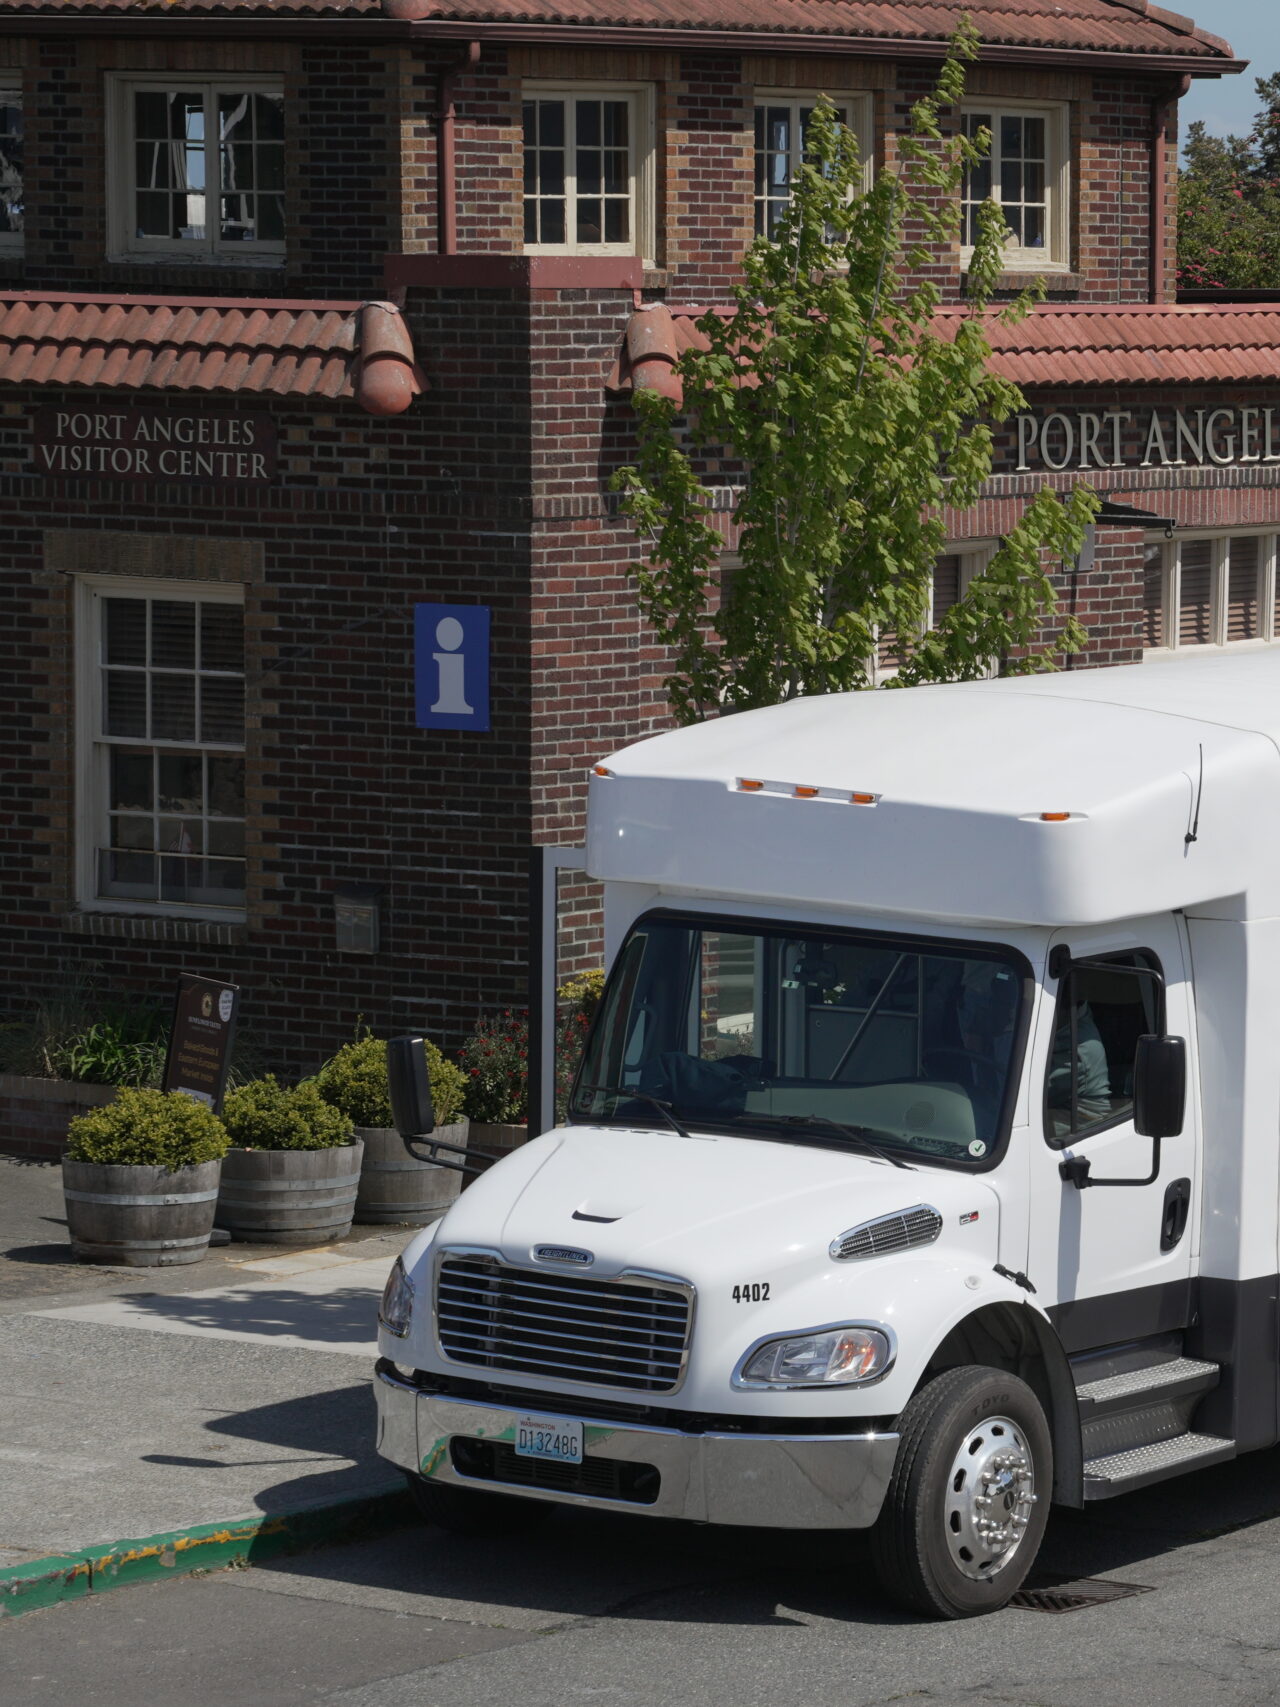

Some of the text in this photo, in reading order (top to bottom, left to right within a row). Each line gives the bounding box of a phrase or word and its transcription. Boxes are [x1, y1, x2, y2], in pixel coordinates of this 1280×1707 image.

[56, 412, 255, 446] PORT ANGELES
[1015, 411, 1132, 471] PORT
[41, 444, 269, 479] VISITOR CENTER
[732, 1282, 770, 1303] 4402
[971, 1393, 1010, 1416] TOYO
[520, 1420, 556, 1431] WASHINGTON
[519, 1428, 578, 1457] D13248G
